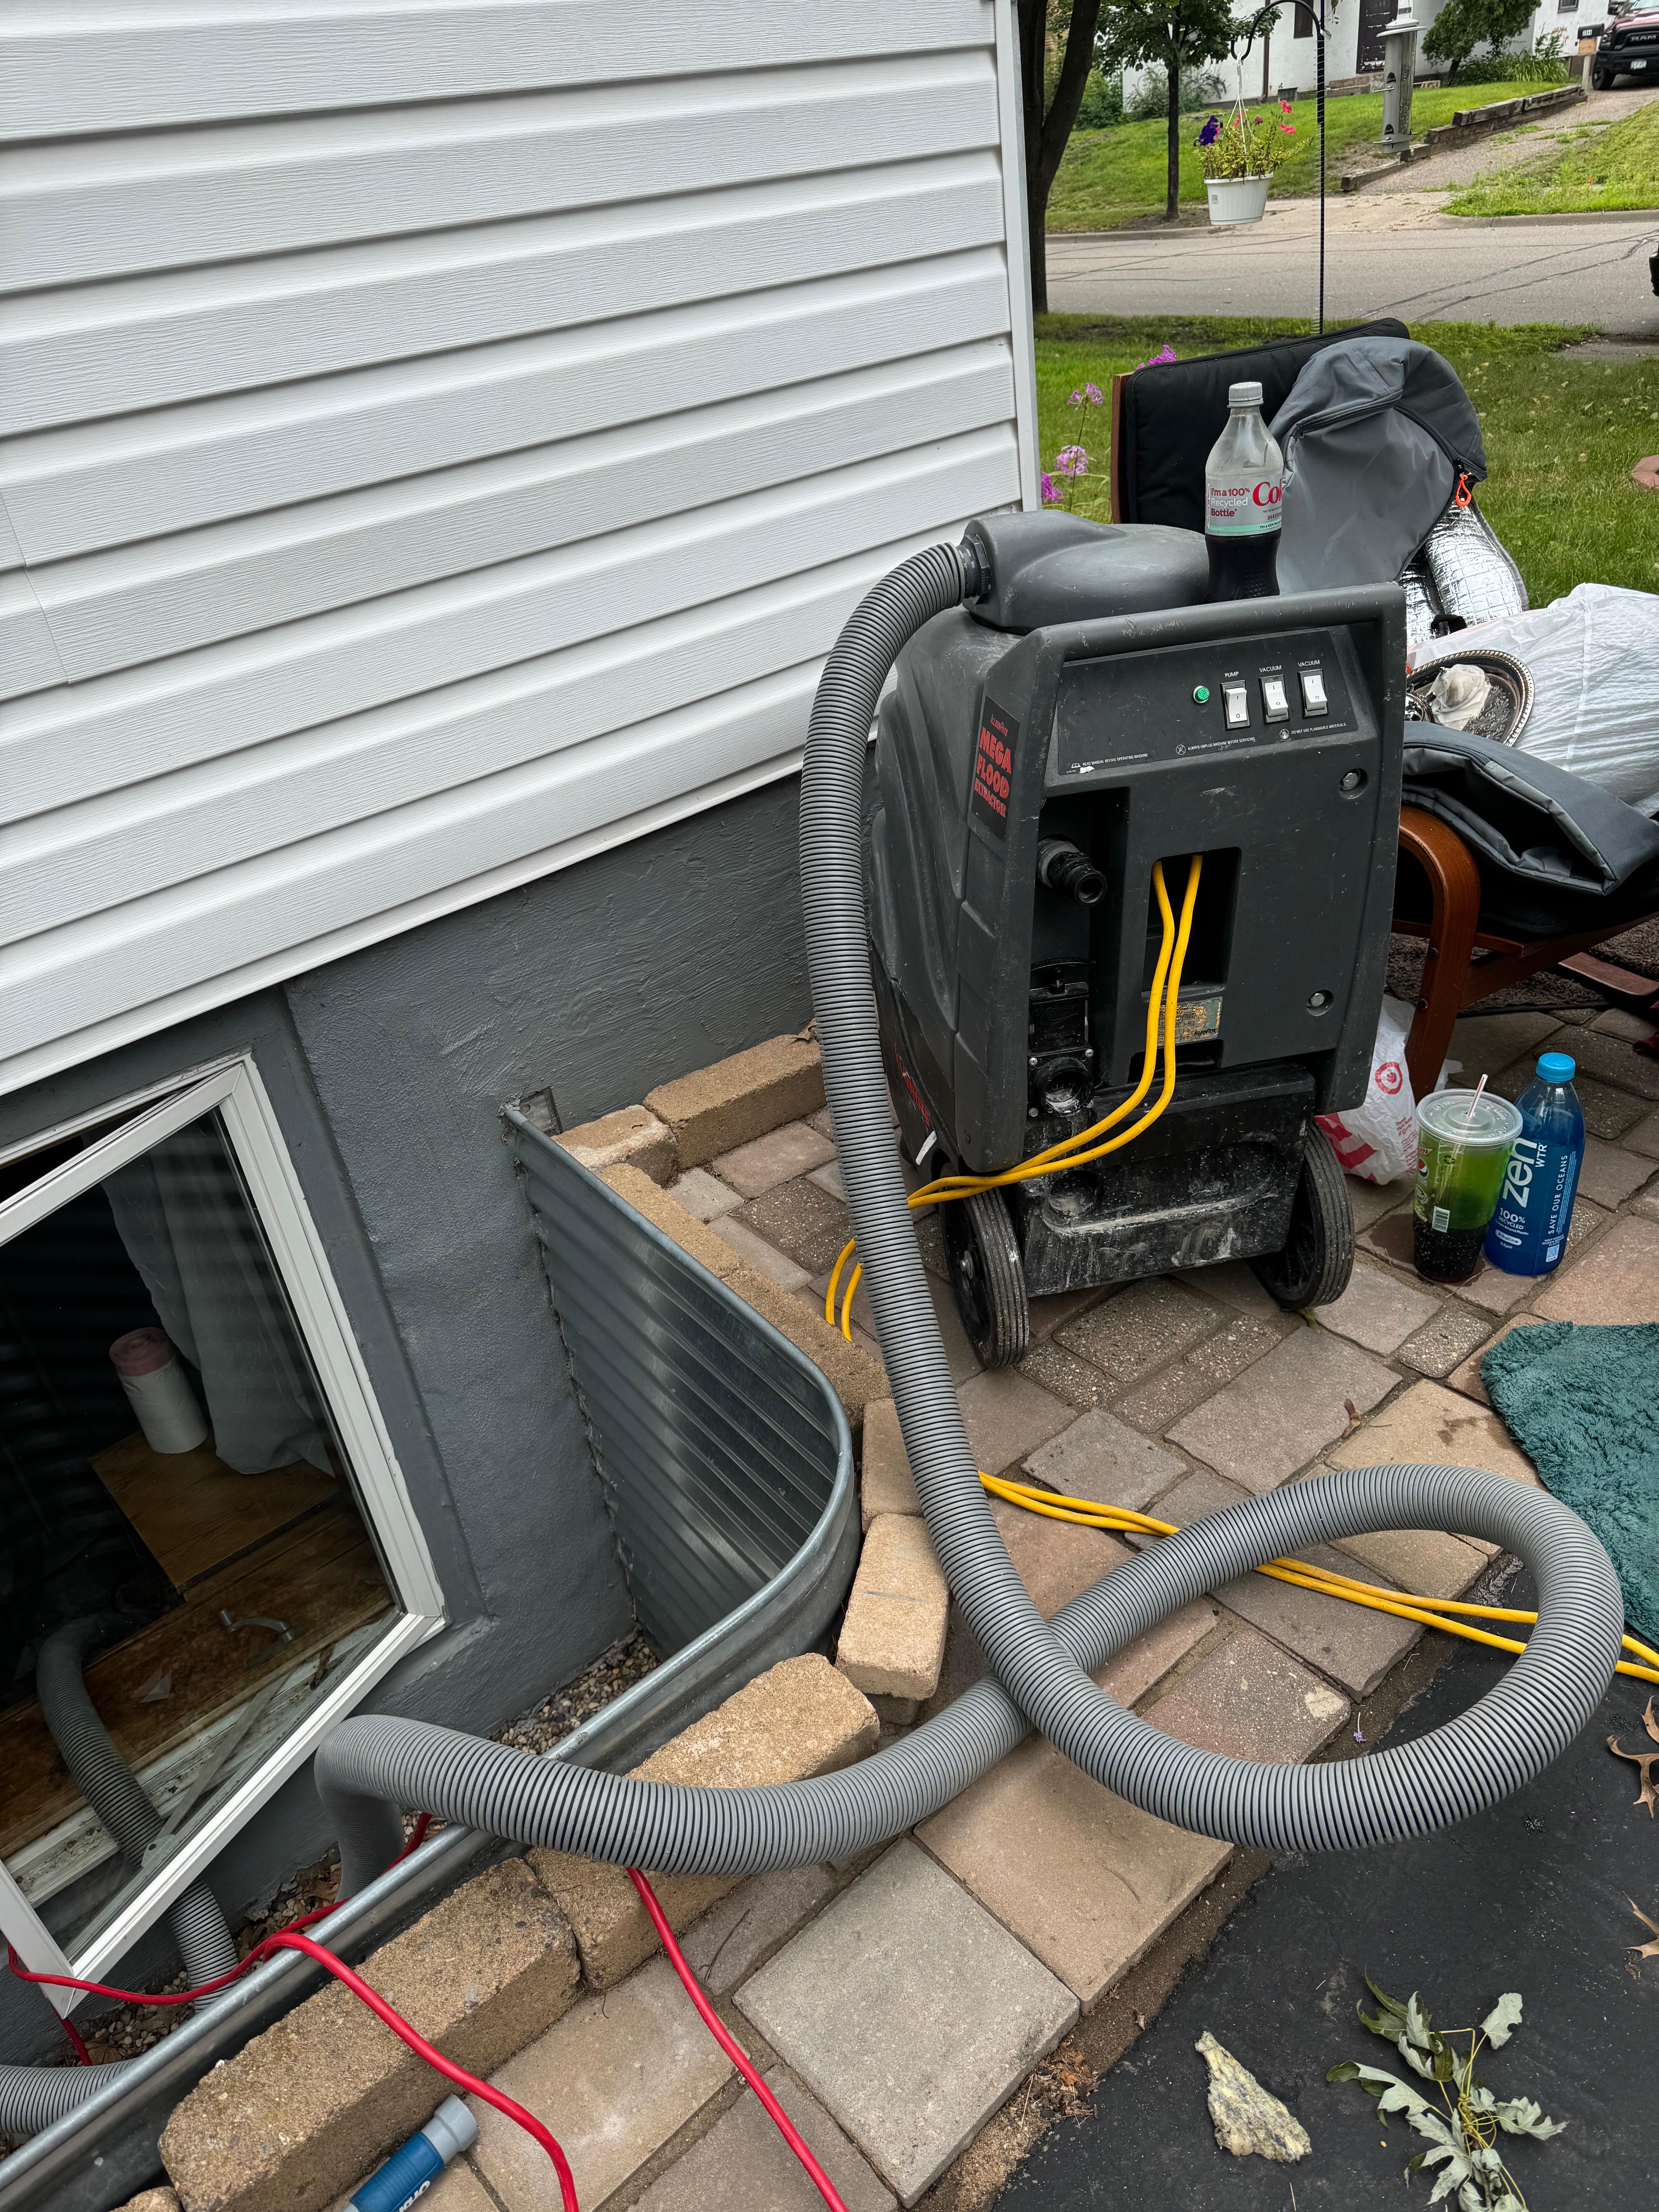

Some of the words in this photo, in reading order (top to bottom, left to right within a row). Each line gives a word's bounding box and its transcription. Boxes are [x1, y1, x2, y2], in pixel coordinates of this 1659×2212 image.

[1211, 488, 1221, 496] I'm
[1228, 488, 1250, 496] 100%
[1211, 497, 1248, 508] Recycled
[1259, 665, 1282, 673] VACUUM
[979, 726, 1012, 775] MEGA
[976, 753, 1010, 799] FLOOD
[974, 777, 1006, 818] EXTRACTOR
[1503, 1137, 1537, 1208] zen
[1556, 1155, 1568, 1191] OCEANS
[1552, 1193, 1561, 1211] OUR
[1500, 1207, 1525, 1224] 100%
[1548, 1215, 1557, 1234] SAVE
[1498, 1232, 1519, 1243] Alkaline
